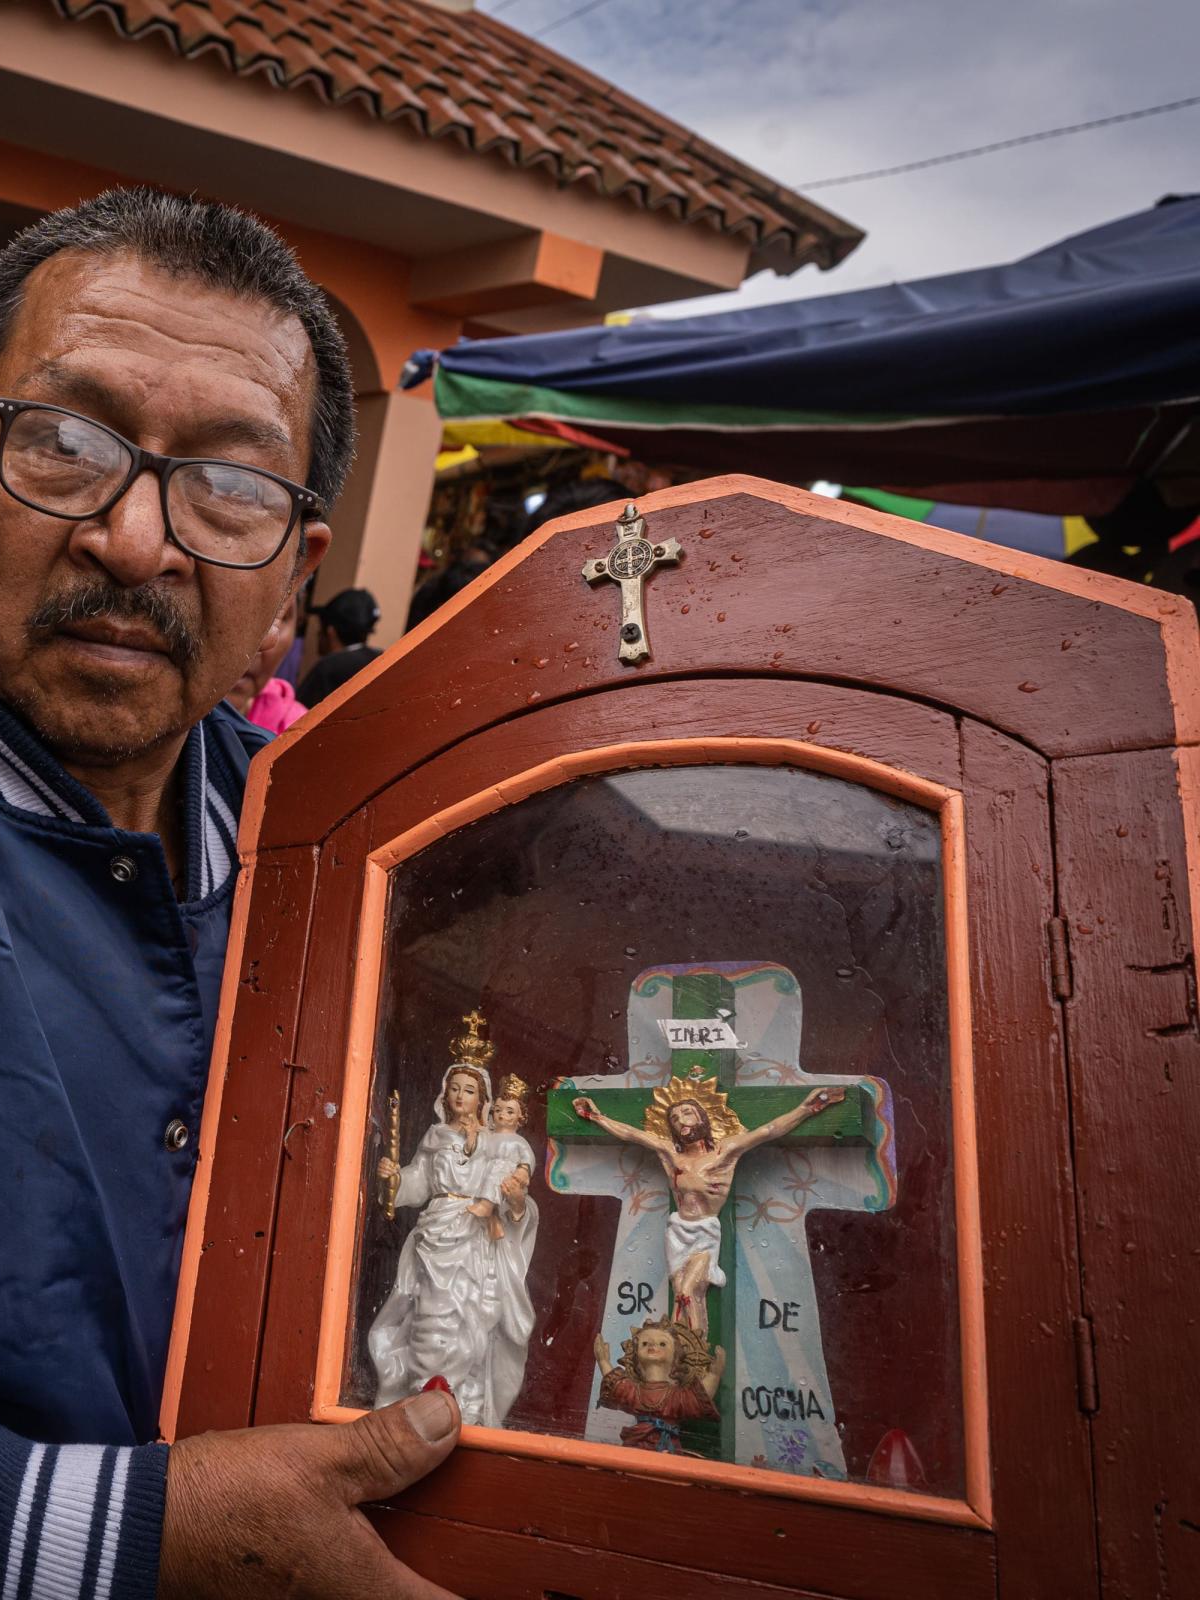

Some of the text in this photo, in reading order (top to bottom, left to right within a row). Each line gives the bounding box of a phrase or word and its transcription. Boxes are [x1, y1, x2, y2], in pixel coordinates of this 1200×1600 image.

[669, 1026, 726, 1046] INRI
[616, 1281, 801, 1332] SR. DE
